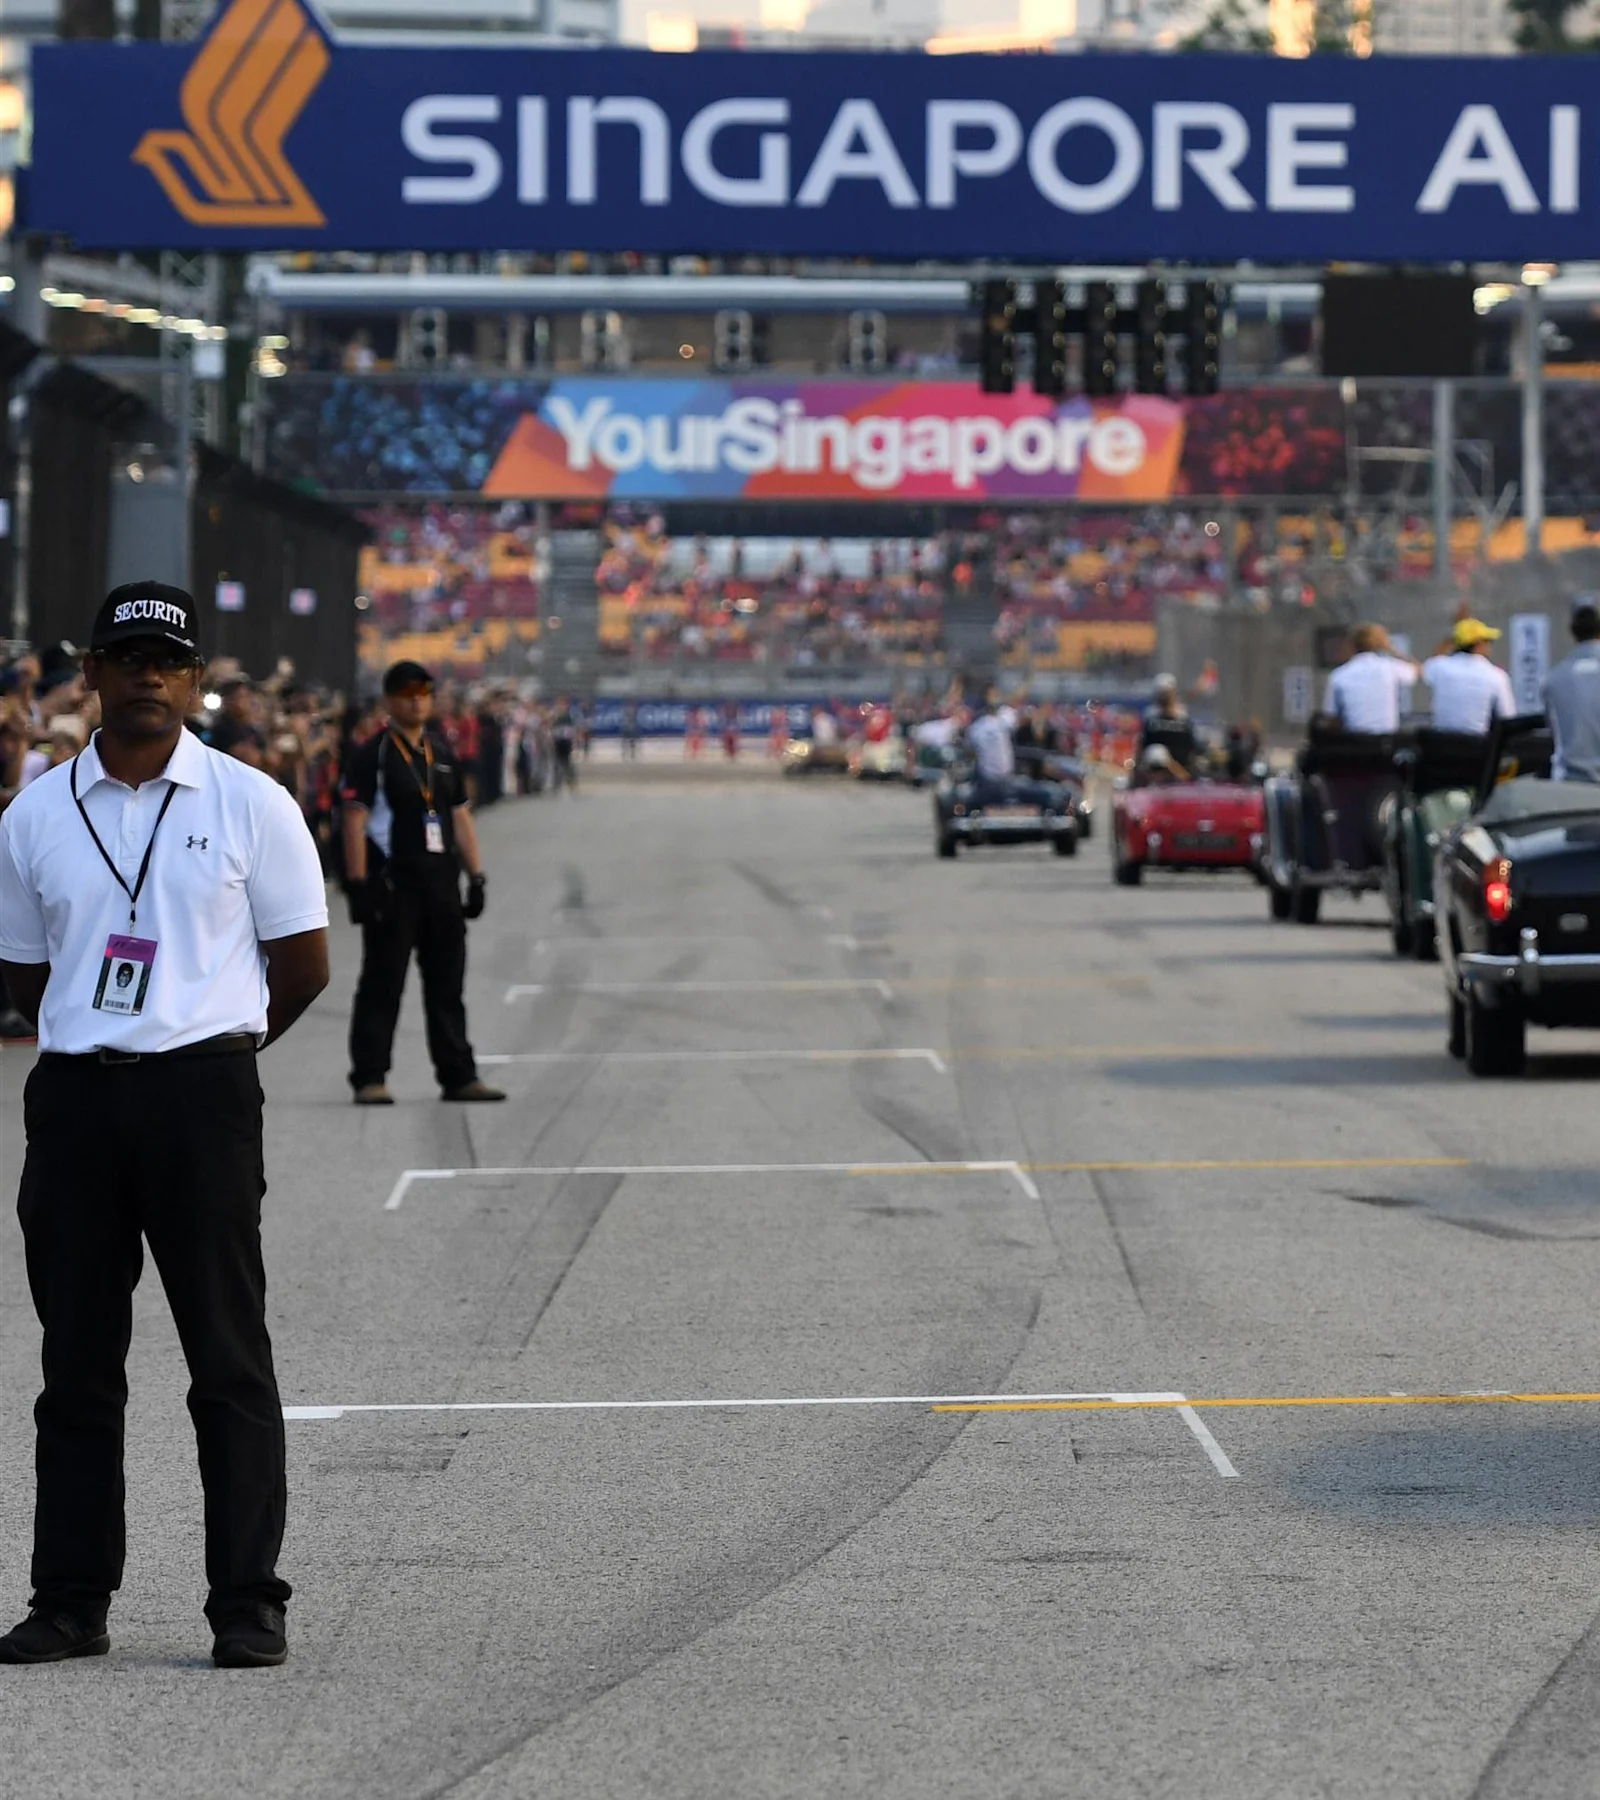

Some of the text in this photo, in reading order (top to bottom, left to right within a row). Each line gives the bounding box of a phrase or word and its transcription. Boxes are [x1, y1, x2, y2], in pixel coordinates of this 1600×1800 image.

[402, 95, 1355, 212] SINGAPORE
[548, 397, 1144, 487] YourSingapore
[113, 599, 187, 629] SECURITY
